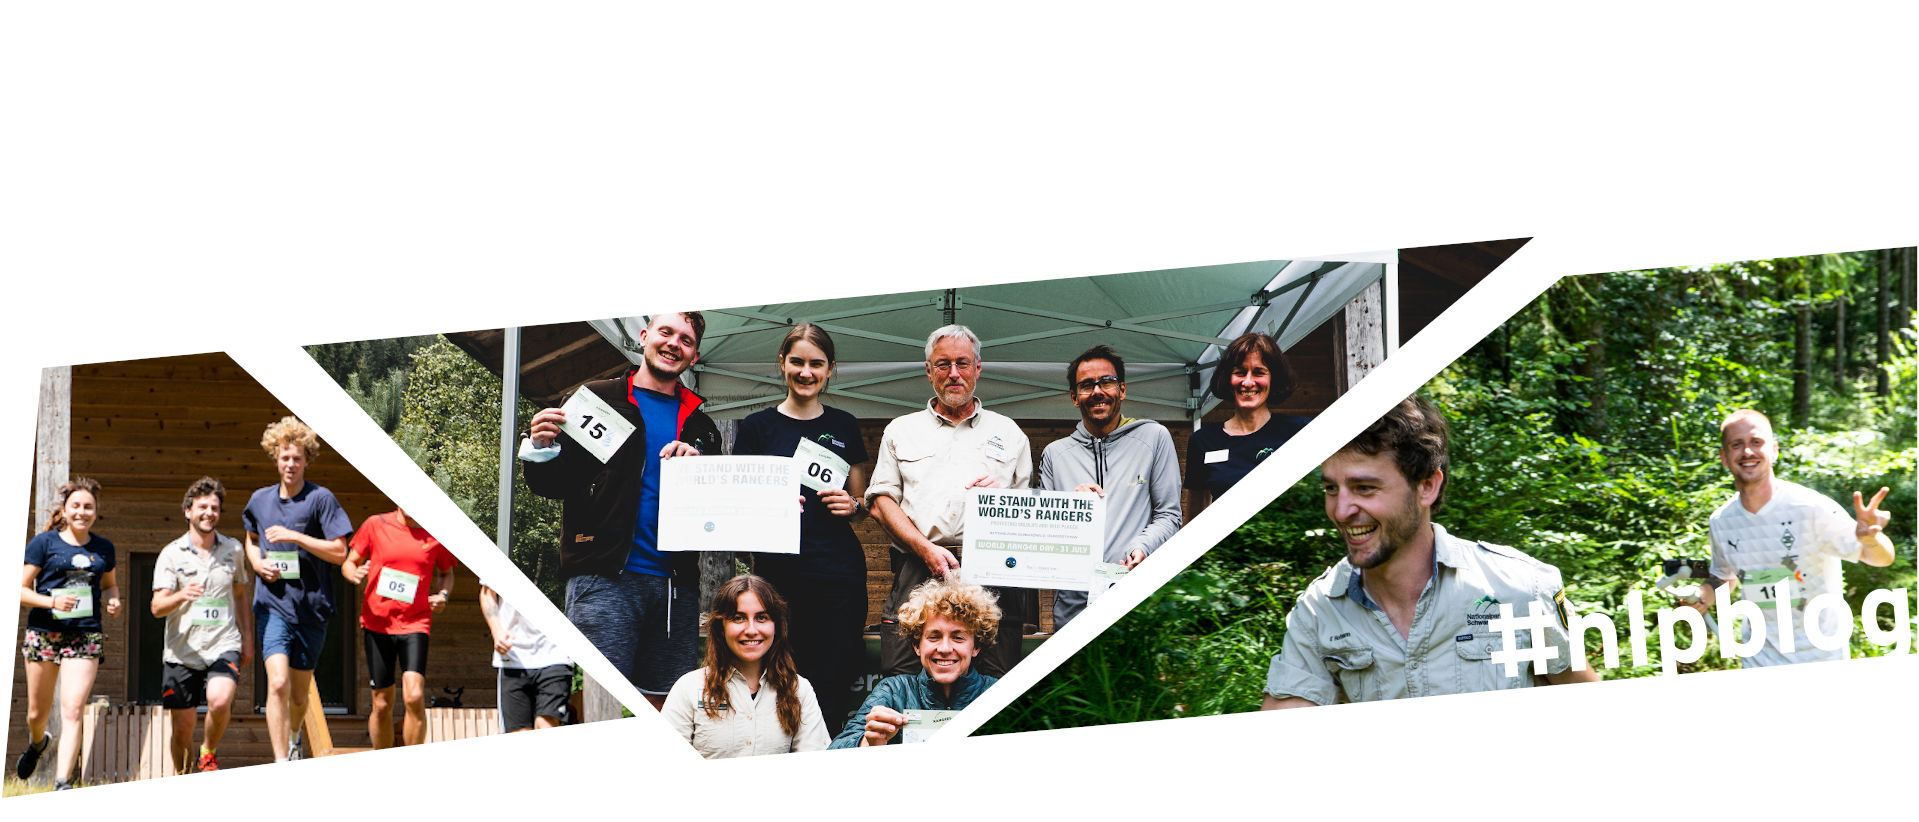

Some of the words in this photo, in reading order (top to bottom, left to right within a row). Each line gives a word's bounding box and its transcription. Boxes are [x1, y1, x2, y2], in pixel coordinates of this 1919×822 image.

[580, 414, 607, 440] 15
[735, 463, 765, 473] WITH
[770, 464, 790, 475] THE
[807, 462, 833, 484] 06
[978, 494, 996, 505] WE
[999, 495, 1036, 507] STAND
[1040, 497, 1069, 508] WITH
[1073, 499, 1094, 510] THE
[978, 507, 1031, 519] WORLD'S
[1036, 509, 1093, 522] RANGERS
[978, 540, 1006, 550] WORLD
[1008, 541, 1037, 551] RANGER
[1039, 544, 1055, 553] DAY
[1060, 545, 1069, 553] 31
[1072, 546, 1088, 554] JULY
[274, 562, 288, 572] 19
[388, 580, 405, 593] 05
[203, 608, 219, 619] 10
[1466, 613, 1502, 621] Nationalpar
